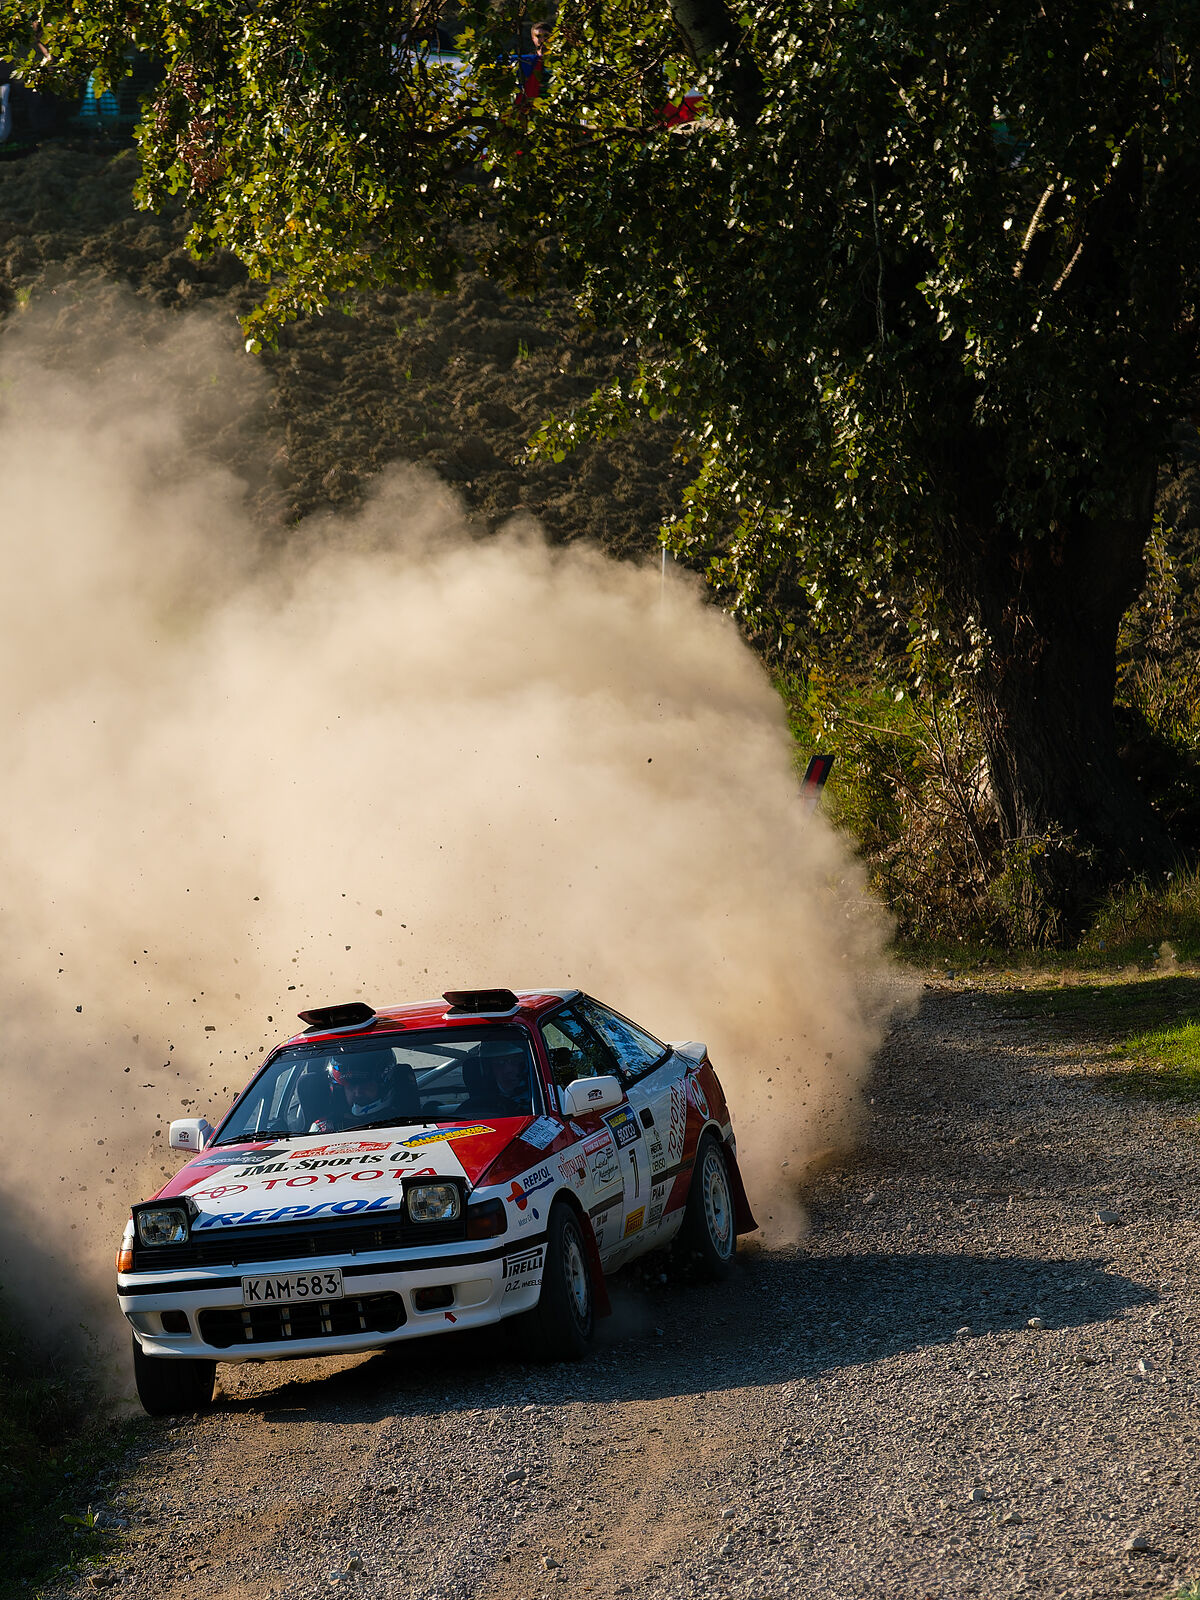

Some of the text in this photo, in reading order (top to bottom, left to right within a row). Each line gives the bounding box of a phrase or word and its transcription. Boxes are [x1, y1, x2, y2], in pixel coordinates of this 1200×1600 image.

[668, 1085, 680, 1160] TOYOTA
[234, 1153, 382, 1178] JML-Sports
[390, 1151, 427, 1163] Oy
[261, 1167, 438, 1190] TOYOTA
[523, 1166, 551, 1189] REPSOL
[628, 1148, 640, 1199] 1
[200, 1196, 393, 1228] REPSOL
[502, 1247, 543, 1279] PIRELLI
[248, 1274, 338, 1300] KAM-583
